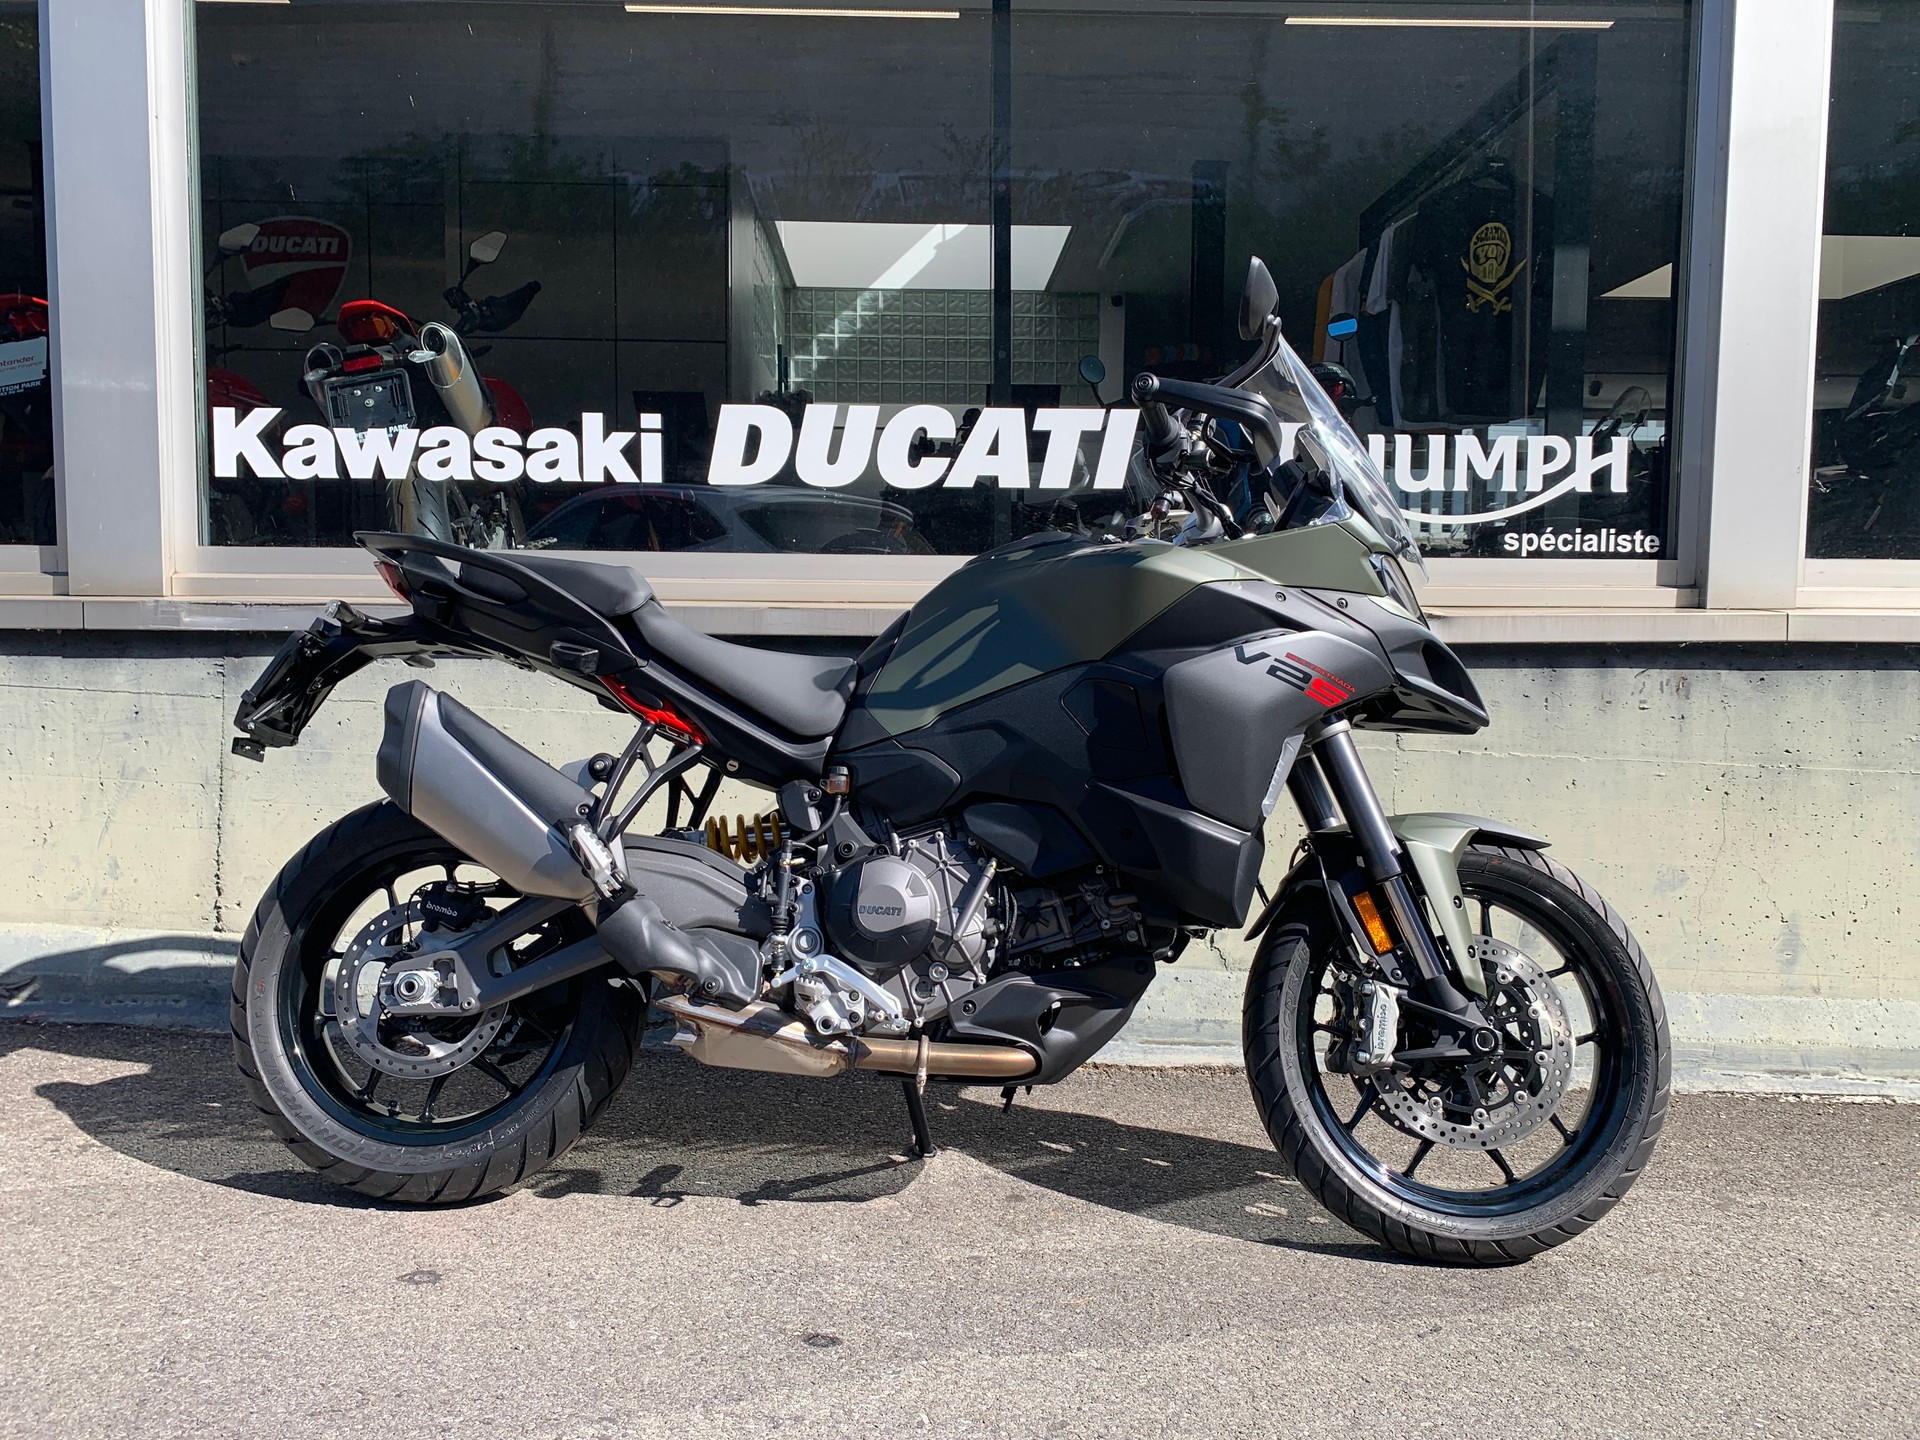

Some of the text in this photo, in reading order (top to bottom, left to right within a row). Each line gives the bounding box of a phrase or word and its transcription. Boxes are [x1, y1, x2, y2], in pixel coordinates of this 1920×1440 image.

[252, 236, 340, 254] DUCATI
[21, 380, 41, 388] PARK
[213, 407, 663, 483] Kawasaki
[708, 404, 1139, 490] DUCATI
[1503, 528, 1661, 556] spécialiste
[426, 900, 459, 917] brembo
[859, 905, 902, 916] DUCATI
